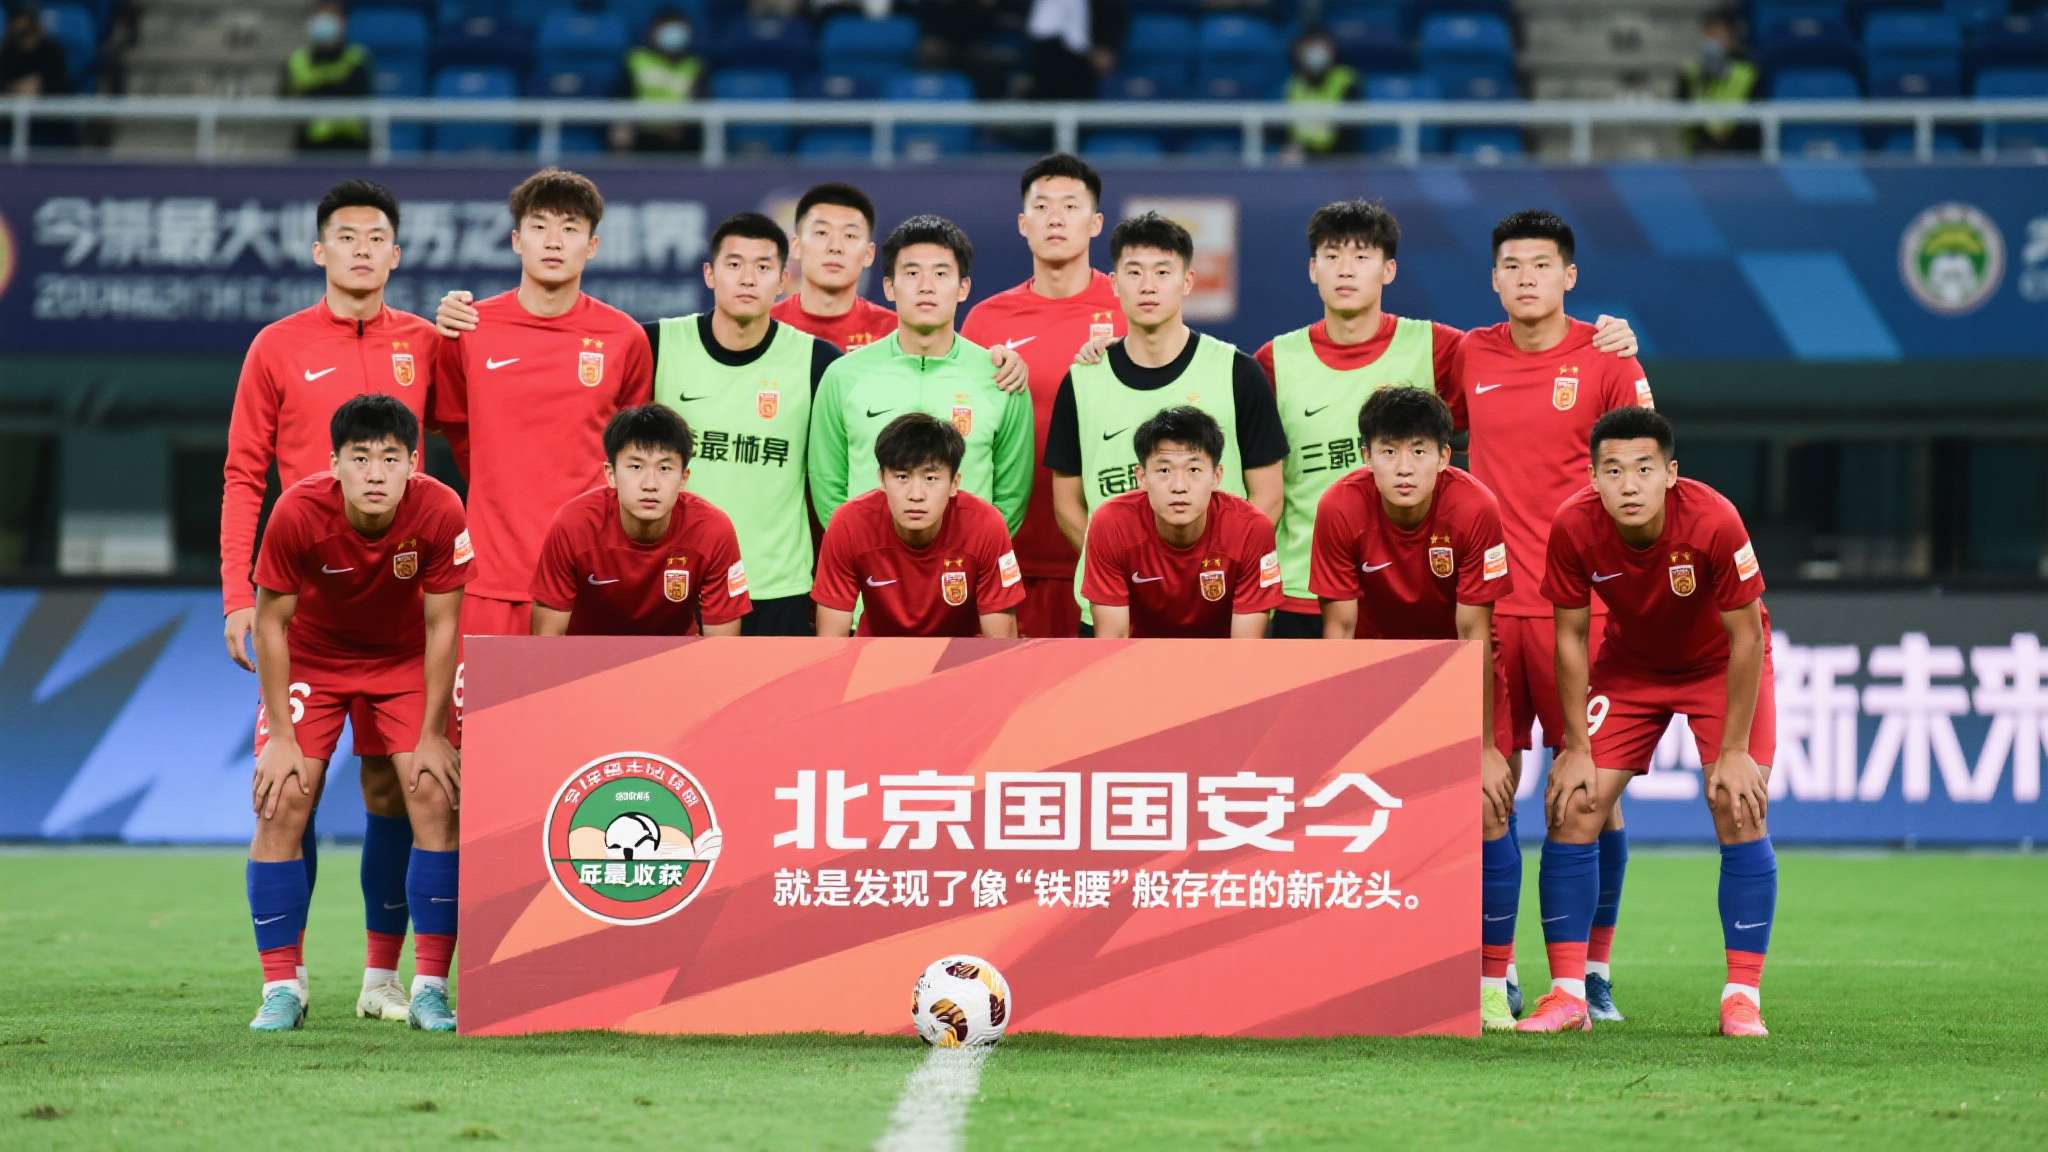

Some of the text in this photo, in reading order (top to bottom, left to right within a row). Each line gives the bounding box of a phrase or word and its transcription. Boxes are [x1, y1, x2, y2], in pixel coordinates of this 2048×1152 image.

[1586, 685, 1610, 737] 9
[773, 769, 1403, 853] 北京国国安今
[773, 867, 1420, 911] 就是发现了像“铁腰”般存在的新龙头。
